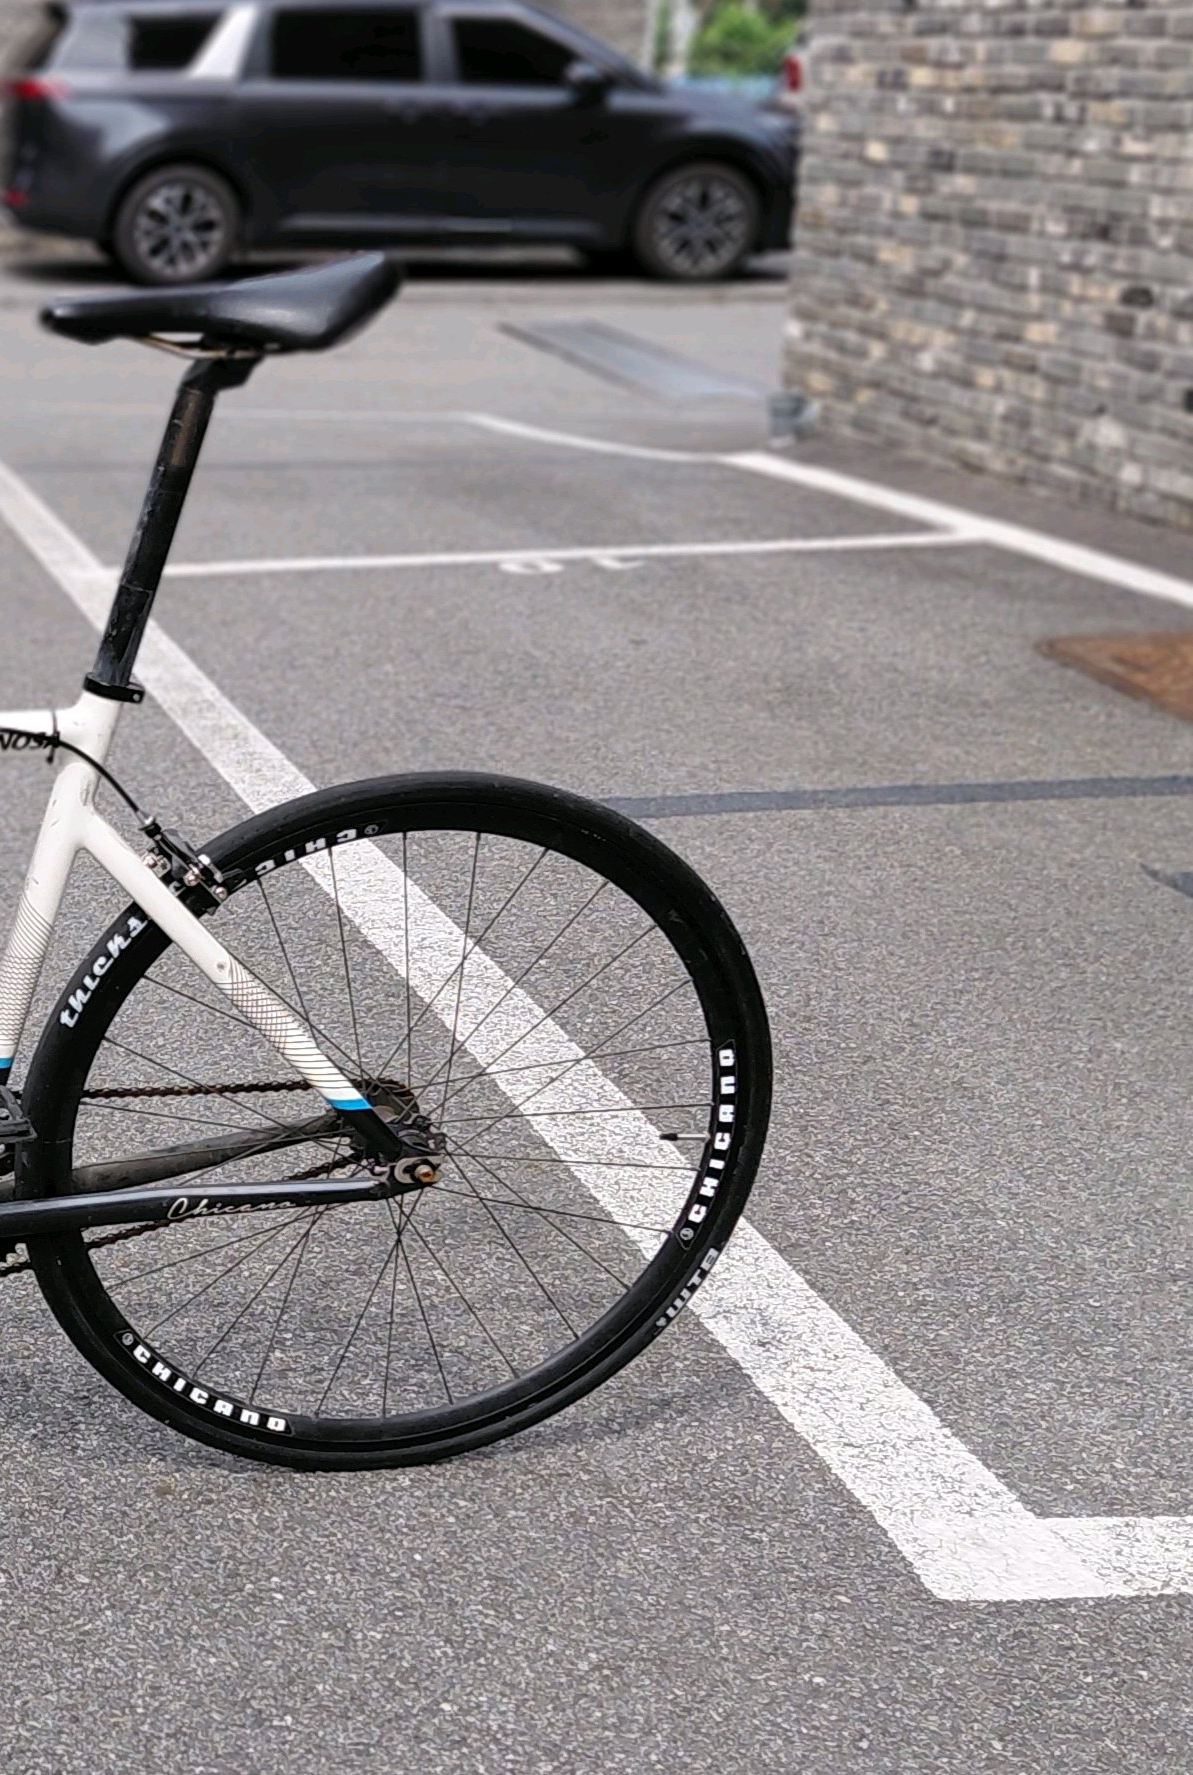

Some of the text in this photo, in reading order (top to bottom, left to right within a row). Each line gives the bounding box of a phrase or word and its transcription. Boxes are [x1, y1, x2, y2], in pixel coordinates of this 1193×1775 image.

[255, 827, 358, 876] CHIC
[687, 1047, 736, 1224] CHICANO
[131, 1345, 288, 1433] CHICANO
